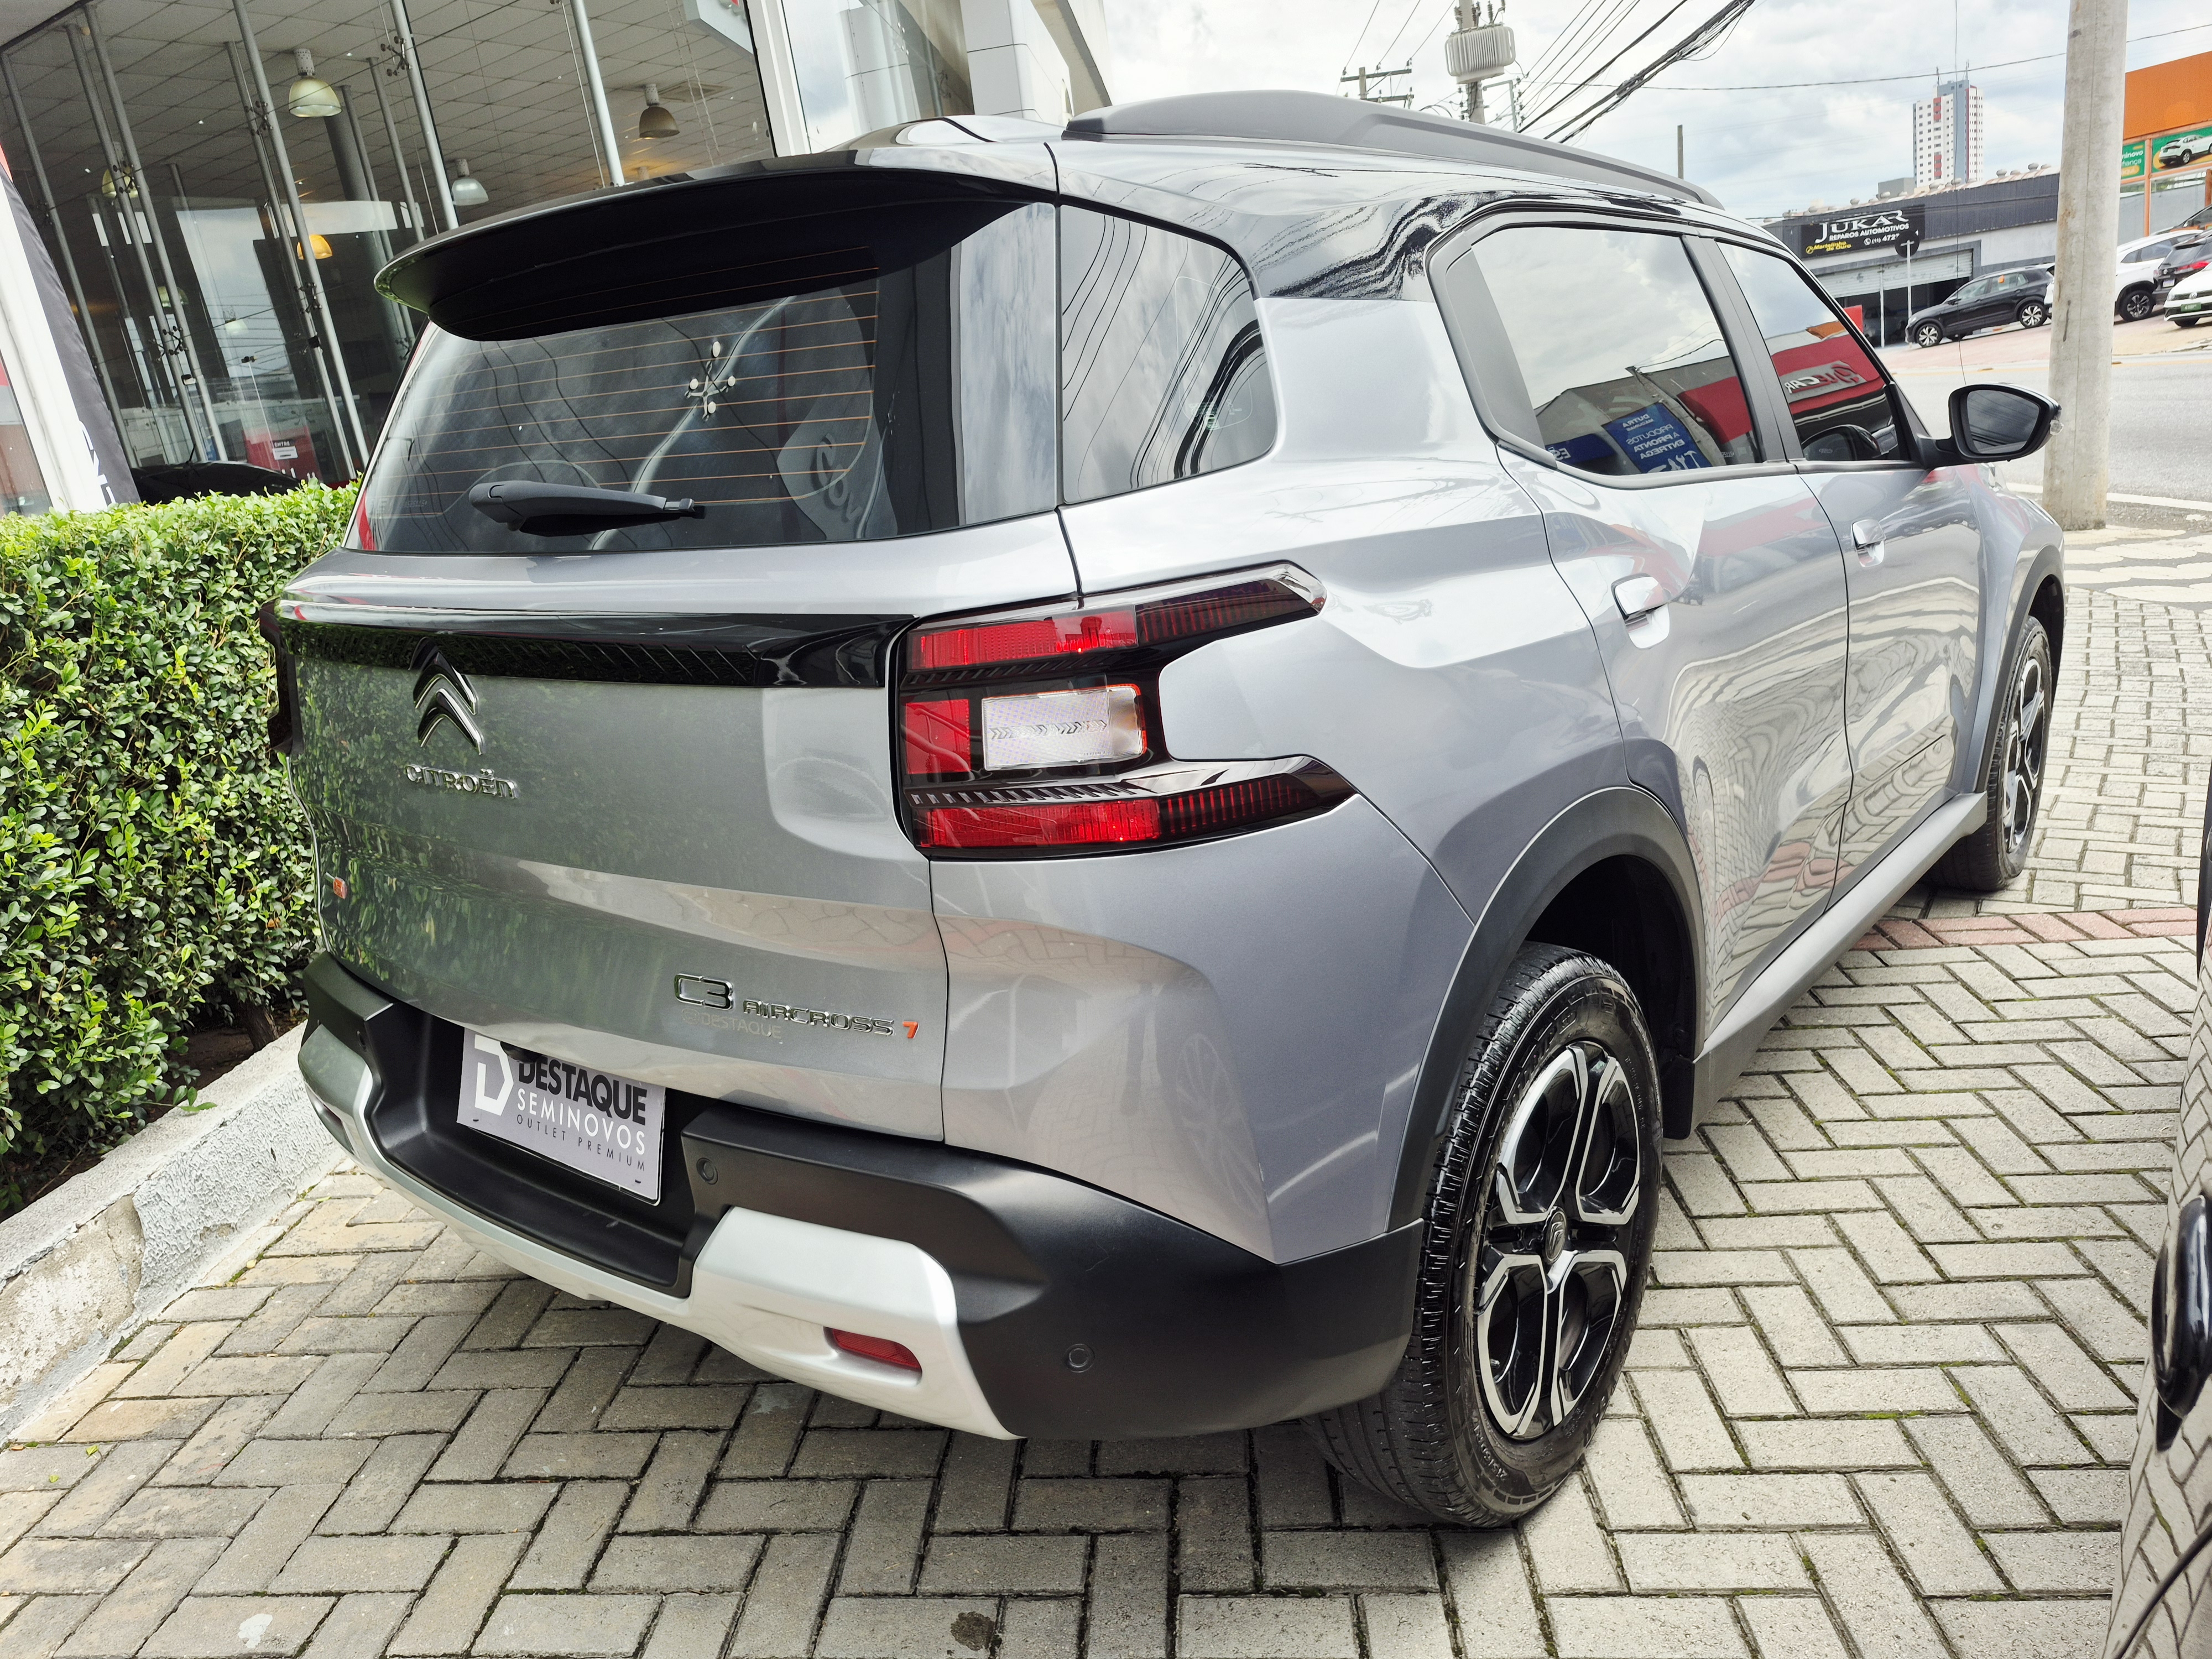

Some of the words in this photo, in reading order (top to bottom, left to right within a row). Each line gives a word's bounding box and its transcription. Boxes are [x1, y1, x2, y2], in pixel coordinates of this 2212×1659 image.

[1814, 210, 1909, 243] JUKAR
[1829, 231, 1859, 241] REPAROS
[1859, 223, 1910, 237] AUTOMOTIVOS
[674, 973, 734, 1010] C3
[743, 999, 895, 1036] AIRCROSS
[902, 1021, 920, 1039] 7
[517, 1088, 645, 1155] SEMINOVOS
[518, 1057, 648, 1125] DESTAQUE
[517, 1114, 566, 1141] OUTLET
[578, 1137, 645, 1172] PREMIUM
